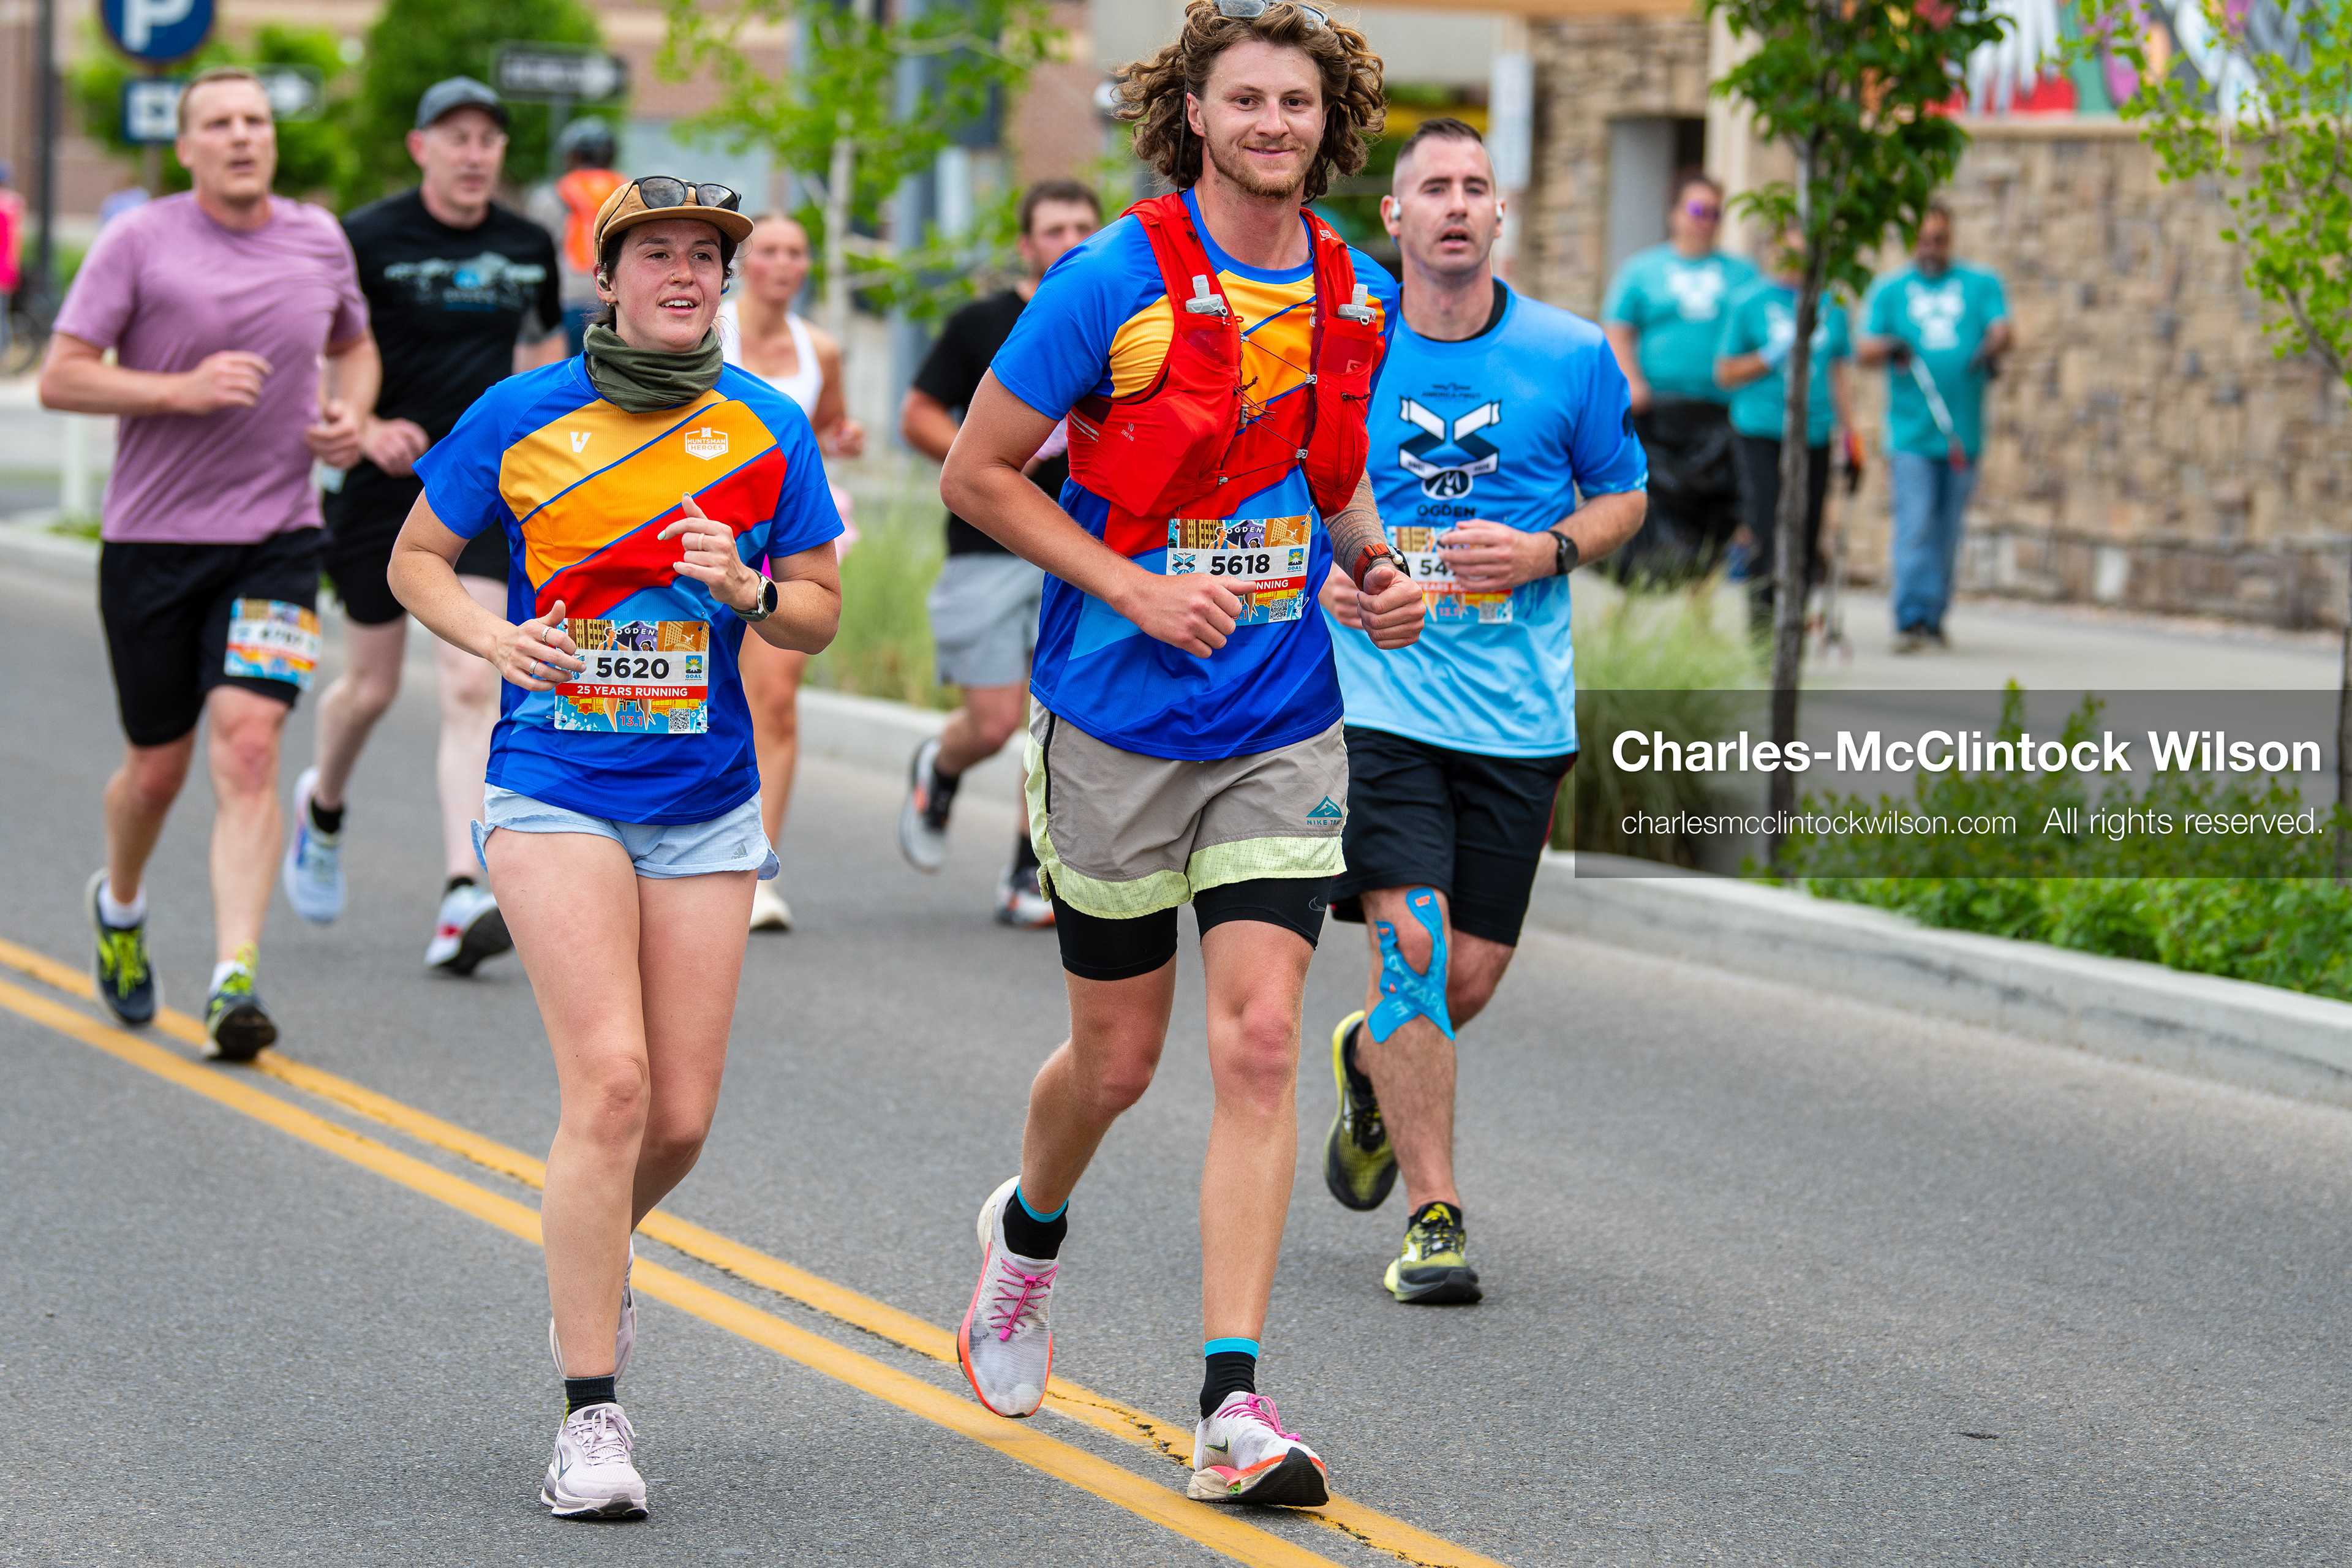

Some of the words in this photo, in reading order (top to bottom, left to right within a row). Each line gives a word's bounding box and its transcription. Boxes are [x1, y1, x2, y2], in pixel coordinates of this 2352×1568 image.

[1417, 504, 1476, 517] OGDEN
[1210, 554, 1270, 576] 5618
[1420, 559, 1457, 576] 54
[1256, 579, 1289, 590] NNING
[595, 657, 669, 679] 5620
[577, 685, 590, 694] 25
[594, 686, 631, 696] YEARS
[635, 687, 688, 696] RUNNING
[620, 715, 643, 726] 13.1
